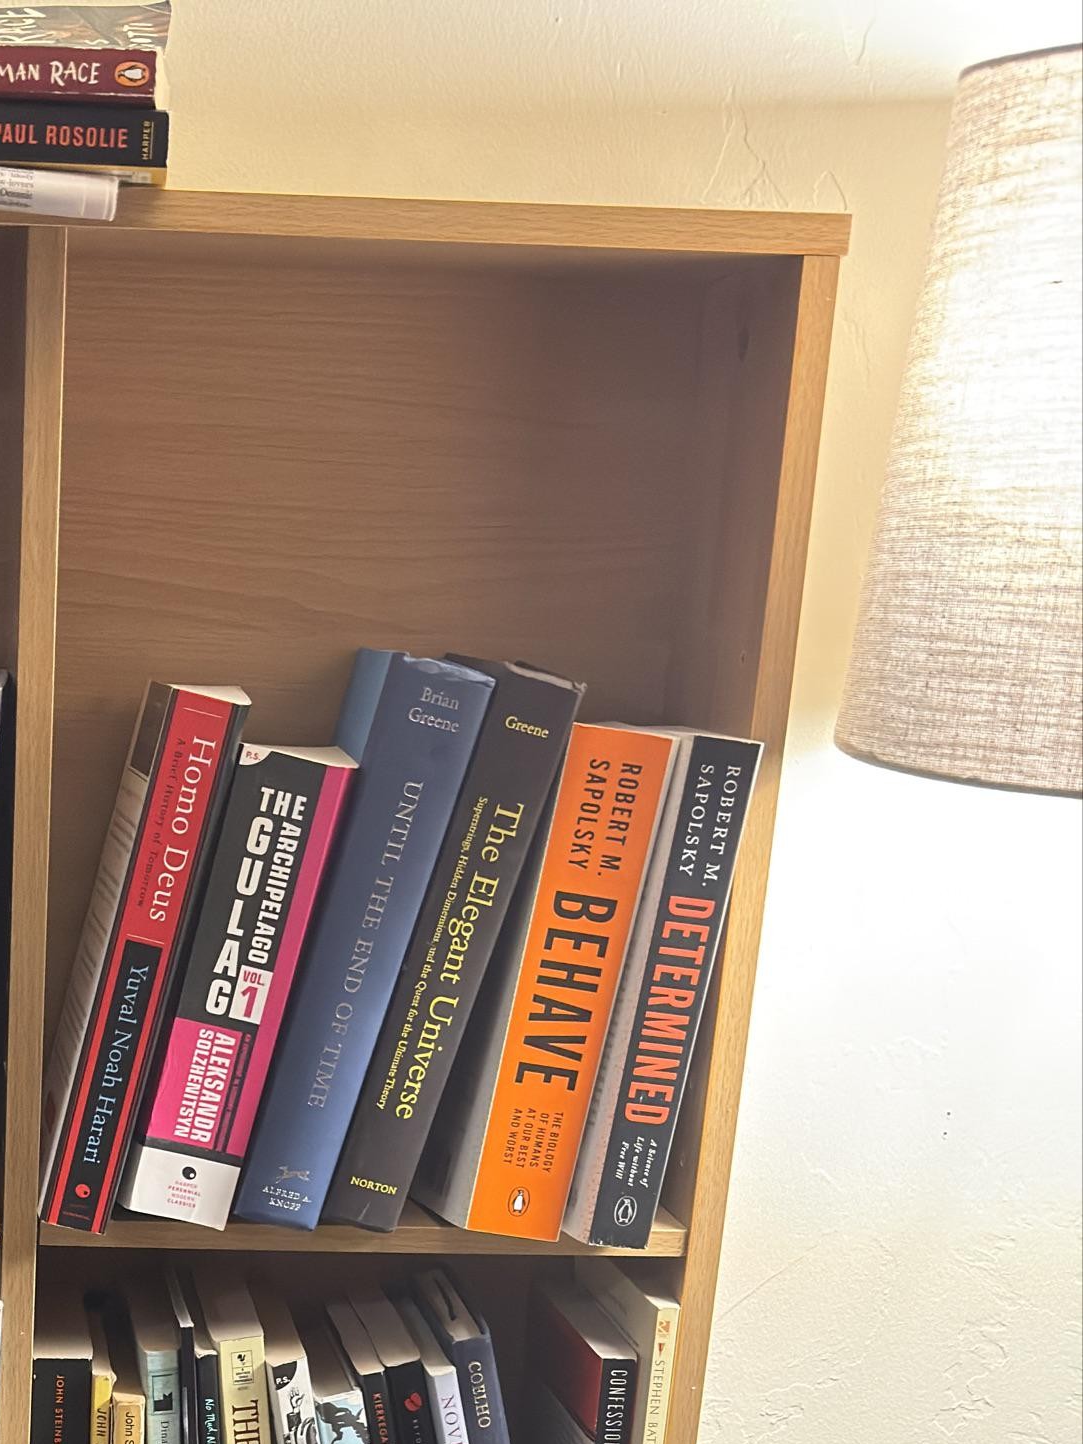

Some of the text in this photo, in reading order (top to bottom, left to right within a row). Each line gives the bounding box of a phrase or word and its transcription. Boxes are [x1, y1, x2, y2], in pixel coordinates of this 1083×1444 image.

[51, 61, 100, 85] RACE
[45, 124, 128, 149] ROSOLIE
[142, 121, 152, 160] HARPER
[505, 715, 549, 739] Greene
[149, 737, 216, 921] Homo Deus
[260, 786, 307, 821] THE
[248, 822, 300, 963] ARCHIPELAGO
[396, 803, 524, 1118] The Elegant Universe
[517, 892, 616, 1089] BEHAVE
[626, 897, 713, 1123] DETERMINED
[83, 966, 149, 1163] Yuval Noah Harari
[174, 1029, 214, 1137] SOLZHENITSYN
[191, 1033, 235, 1142] ALEKSANDR
[350, 1175, 398, 1195] NORTON
[125, 1411, 135, 1437] John
